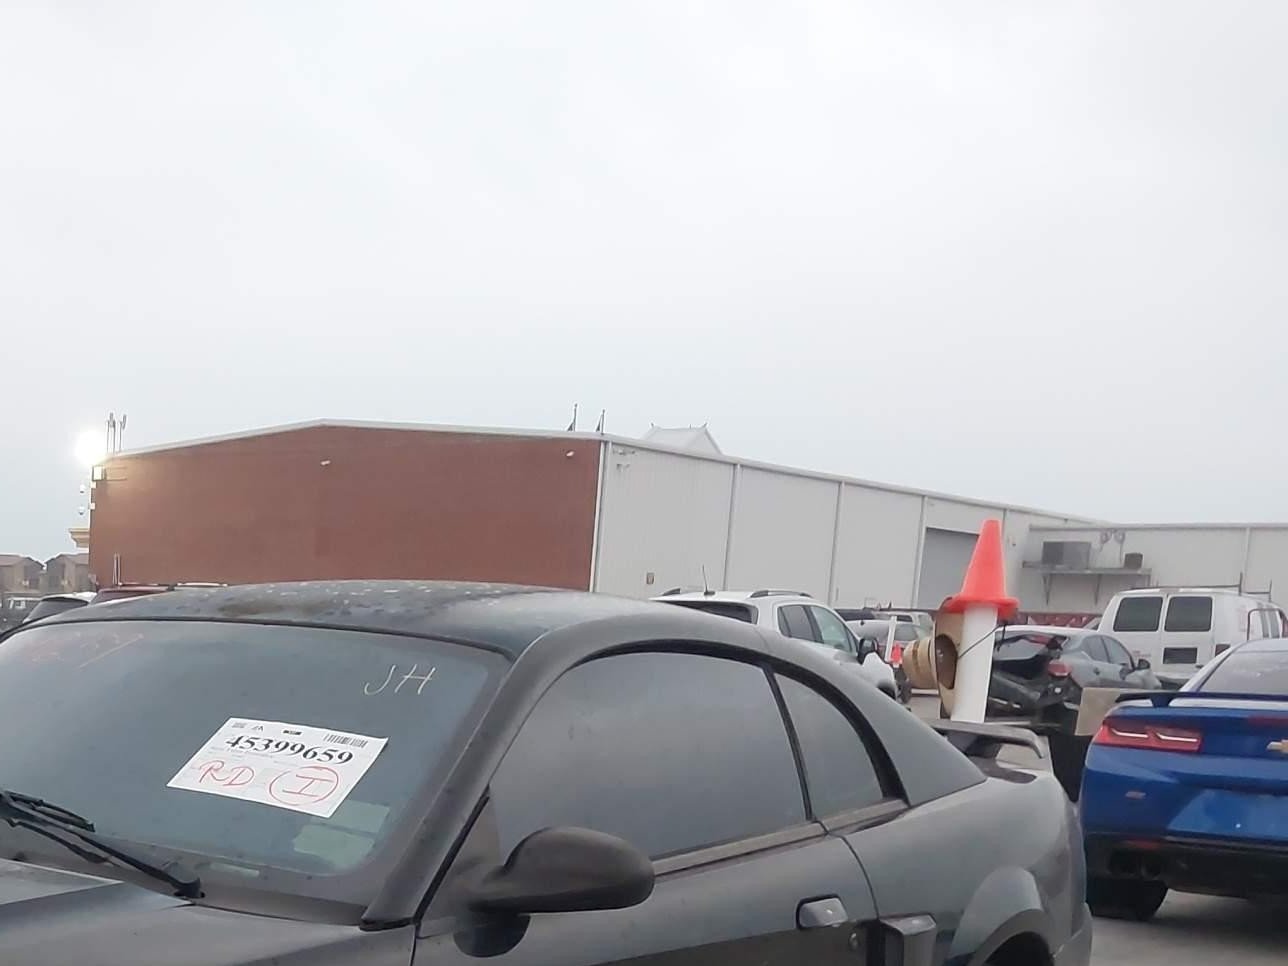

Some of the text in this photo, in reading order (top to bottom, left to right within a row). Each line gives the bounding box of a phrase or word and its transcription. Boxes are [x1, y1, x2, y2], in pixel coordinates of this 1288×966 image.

[364, 664, 437, 695] JH
[226, 735, 354, 764] 45399659
[199, 760, 255, 787] RD
